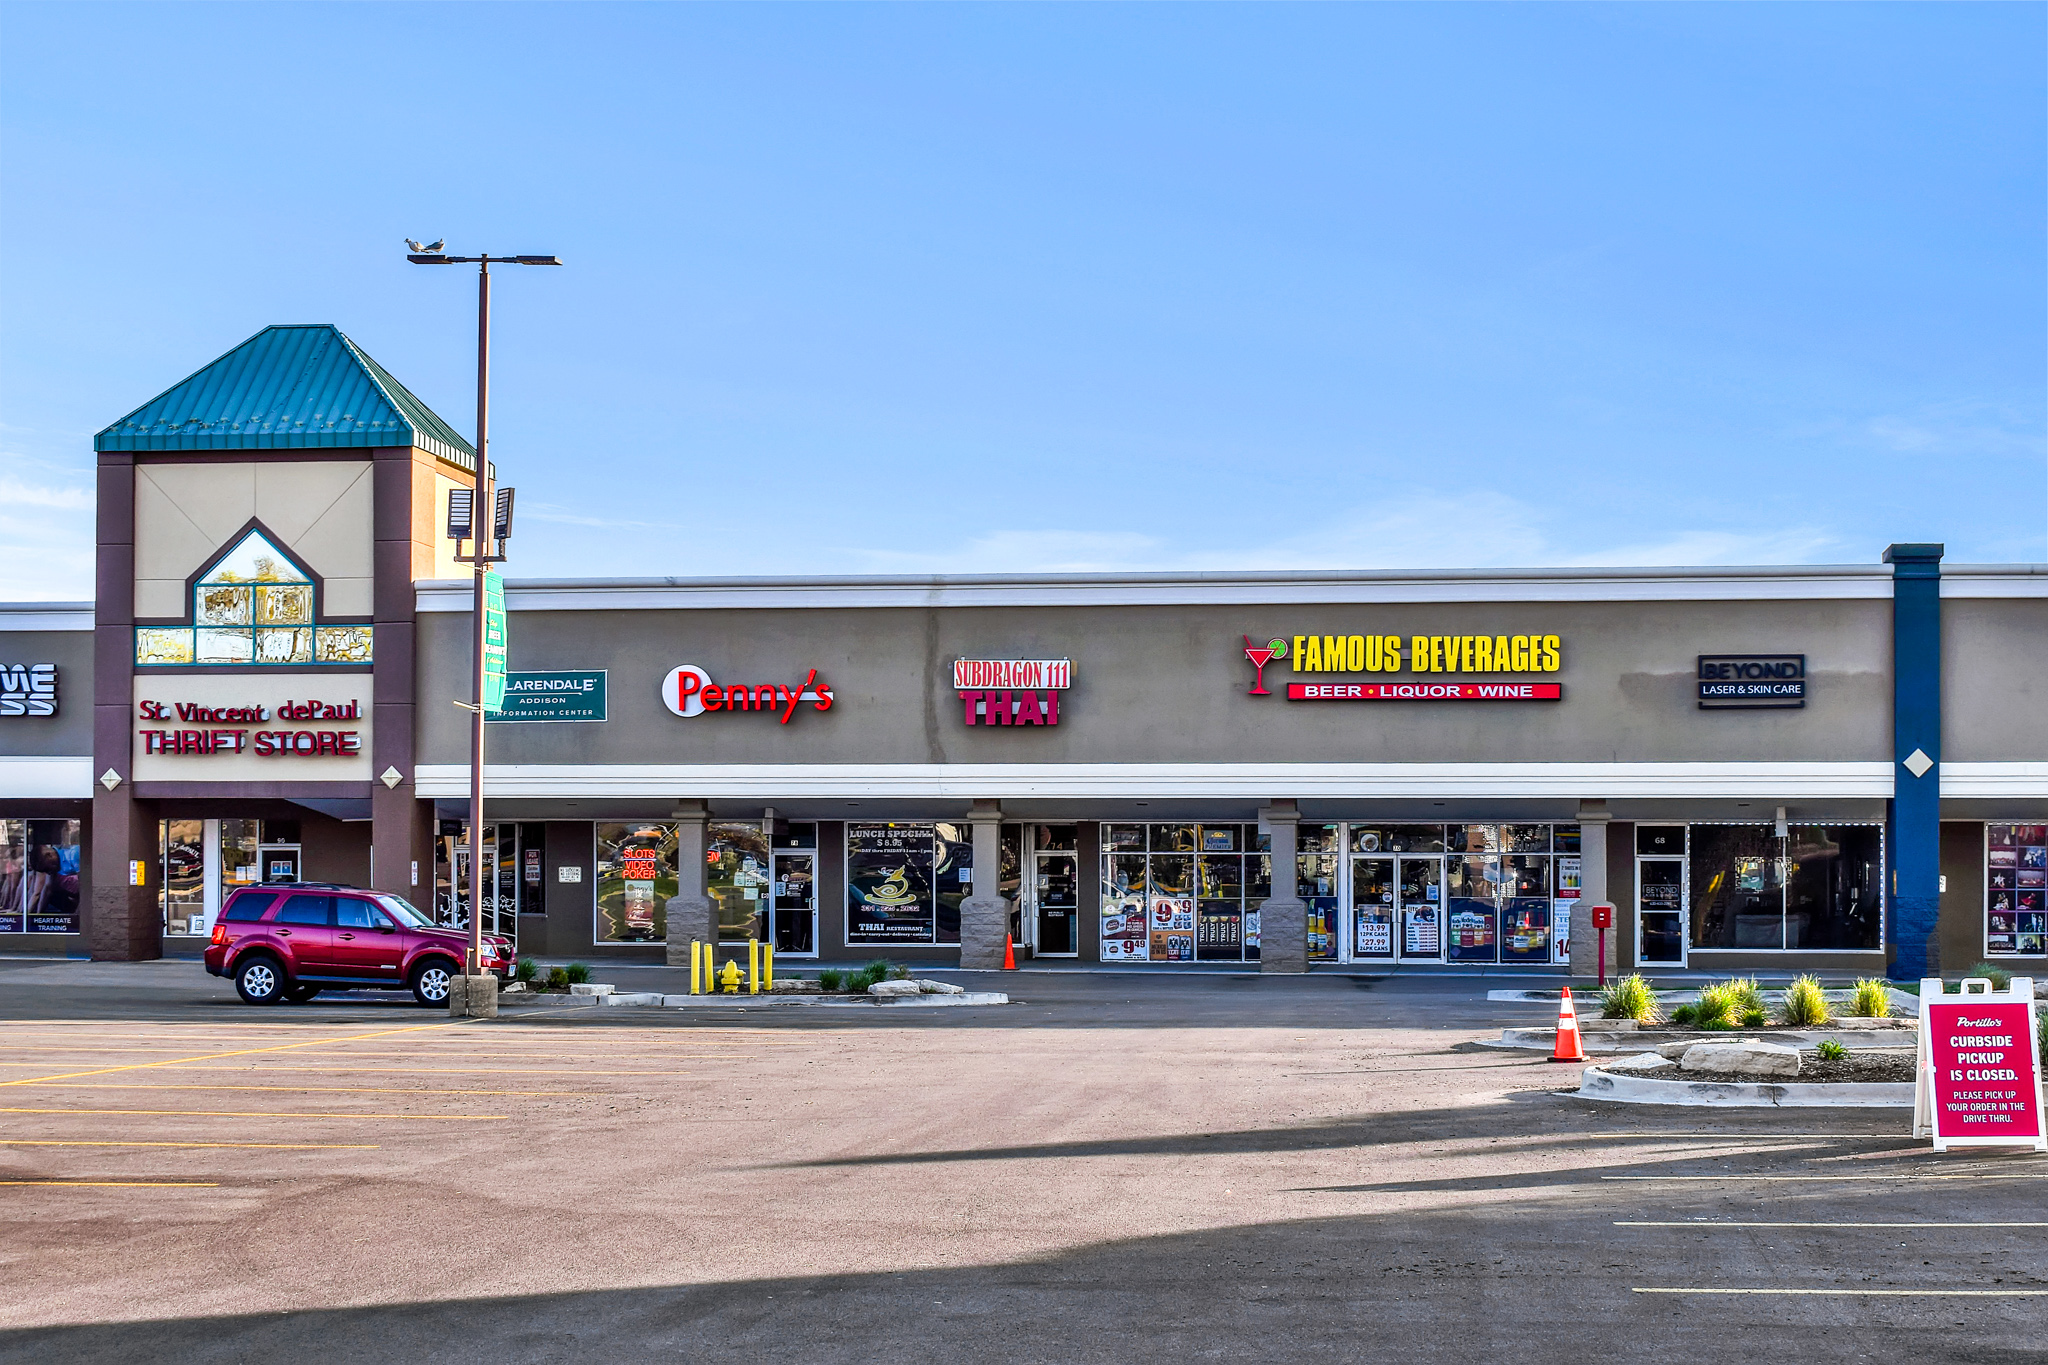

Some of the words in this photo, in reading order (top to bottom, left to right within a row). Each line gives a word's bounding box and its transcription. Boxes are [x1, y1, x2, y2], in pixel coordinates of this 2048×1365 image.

[1292, 635, 1401, 672] FAMOUS
[1411, 635, 1560, 672] BEVERAGES
[955, 661, 1042, 687] SUBDRAGON
[1046, 662, 1068, 688] 111
[1704, 662, 1798, 679] BEYOND
[505, 678, 594, 691] LARENDALE
[1703, 685, 1736, 695] LASER
[1737, 685, 1746, 694] &
[1747, 684, 1772, 694] SKIN
[1773, 684, 1801, 694] CARE
[677, 669, 833, 724] Penny's
[1304, 685, 1362, 698] BEER
[1380, 685, 1461, 698] LIQUOR
[1478, 685, 1533, 698] WINE
[519, 697, 566, 705] ADDISON
[139, 700, 170, 720] St.
[174, 702, 266, 723] Vincent
[277, 699, 359, 720] dePaul
[959, 690, 1058, 725] THAI
[139, 729, 249, 755] THRIFT
[254, 731, 359, 757] STORE
[849, 830, 886, 839] LUNCH
[1051, 842, 1063, 850] 74
[623, 849, 656, 859] SLOTS
[707, 851, 720, 862] EN
[625, 860, 655, 870] VIDEO
[622, 869, 656, 880] POKER
[1645, 886, 1678, 894] BEYOND
[858, 923, 885, 931] THAI
[1362, 924, 1386, 932] $13.99
[1362, 938, 1386, 946] $27.99
[1956, 1016, 2003, 1028] Portillo's
[1950, 1035, 2013, 1048] CURBSIDE
[1957, 1052, 2004, 1064] PICKUP
[1950, 1069, 1963, 1081] IS
[1966, 1069, 2019, 1081] CLOSED.
[1953, 1091, 1983, 1100] PLEASE
[1984, 1091, 2003, 1100] PICK
[2004, 1091, 2016, 1099] UP
[1946, 1103, 1968, 1111] YOUR
[1969, 1103, 1997, 1111] ORDER
[1999, 1103, 2008, 1111] IN
[2009, 1102, 2025, 1111] THE
[1963, 1115, 1987, 1123] DRIVE
[1989, 1114, 2013, 1123] THRU.
